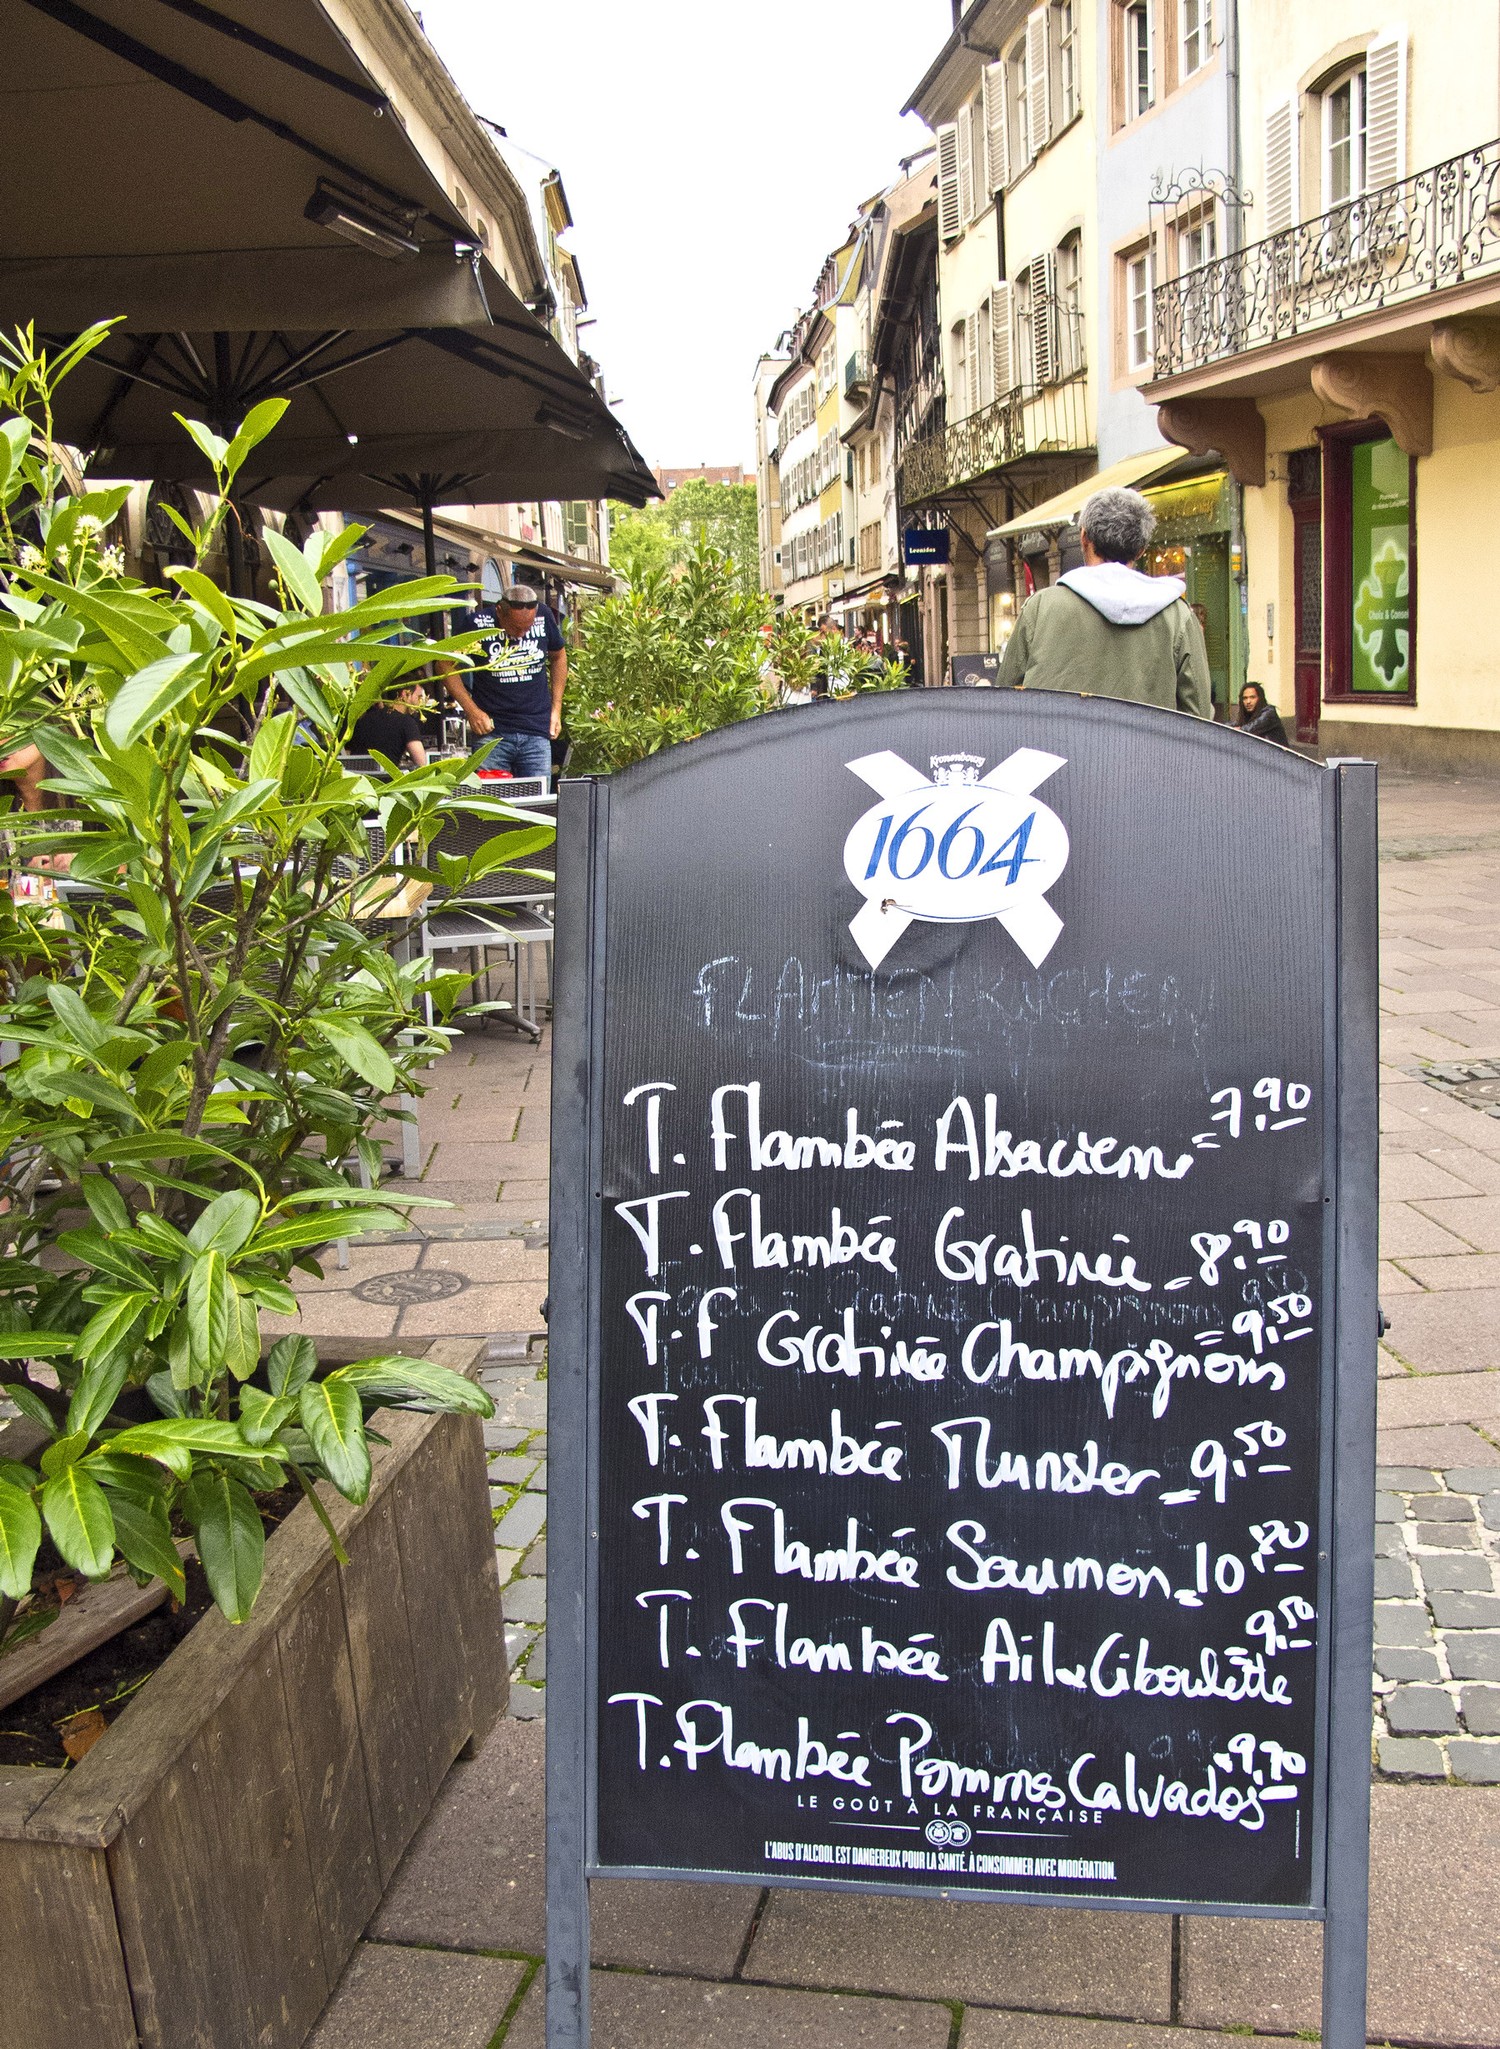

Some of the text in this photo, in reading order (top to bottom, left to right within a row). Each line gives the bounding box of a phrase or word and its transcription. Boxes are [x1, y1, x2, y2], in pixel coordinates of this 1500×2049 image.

[929, 752, 986, 769] Kronenbourg
[863, 801, 1041, 886] 1664
[945, 1519, 1171, 1600] Saumon
[980, 1617, 1055, 1686] Ail
[797, 1795, 1104, 1825] LE GOÛT À LA FRANÇAISE
[1068, 1752, 1265, 1831] Calvados
[765, 1841, 1117, 1880] L'ABUS D'ALCOOL EST DANGEREUX POUR LA SANTÉ. À CONSOMMER AVEC MODÉRATION.
